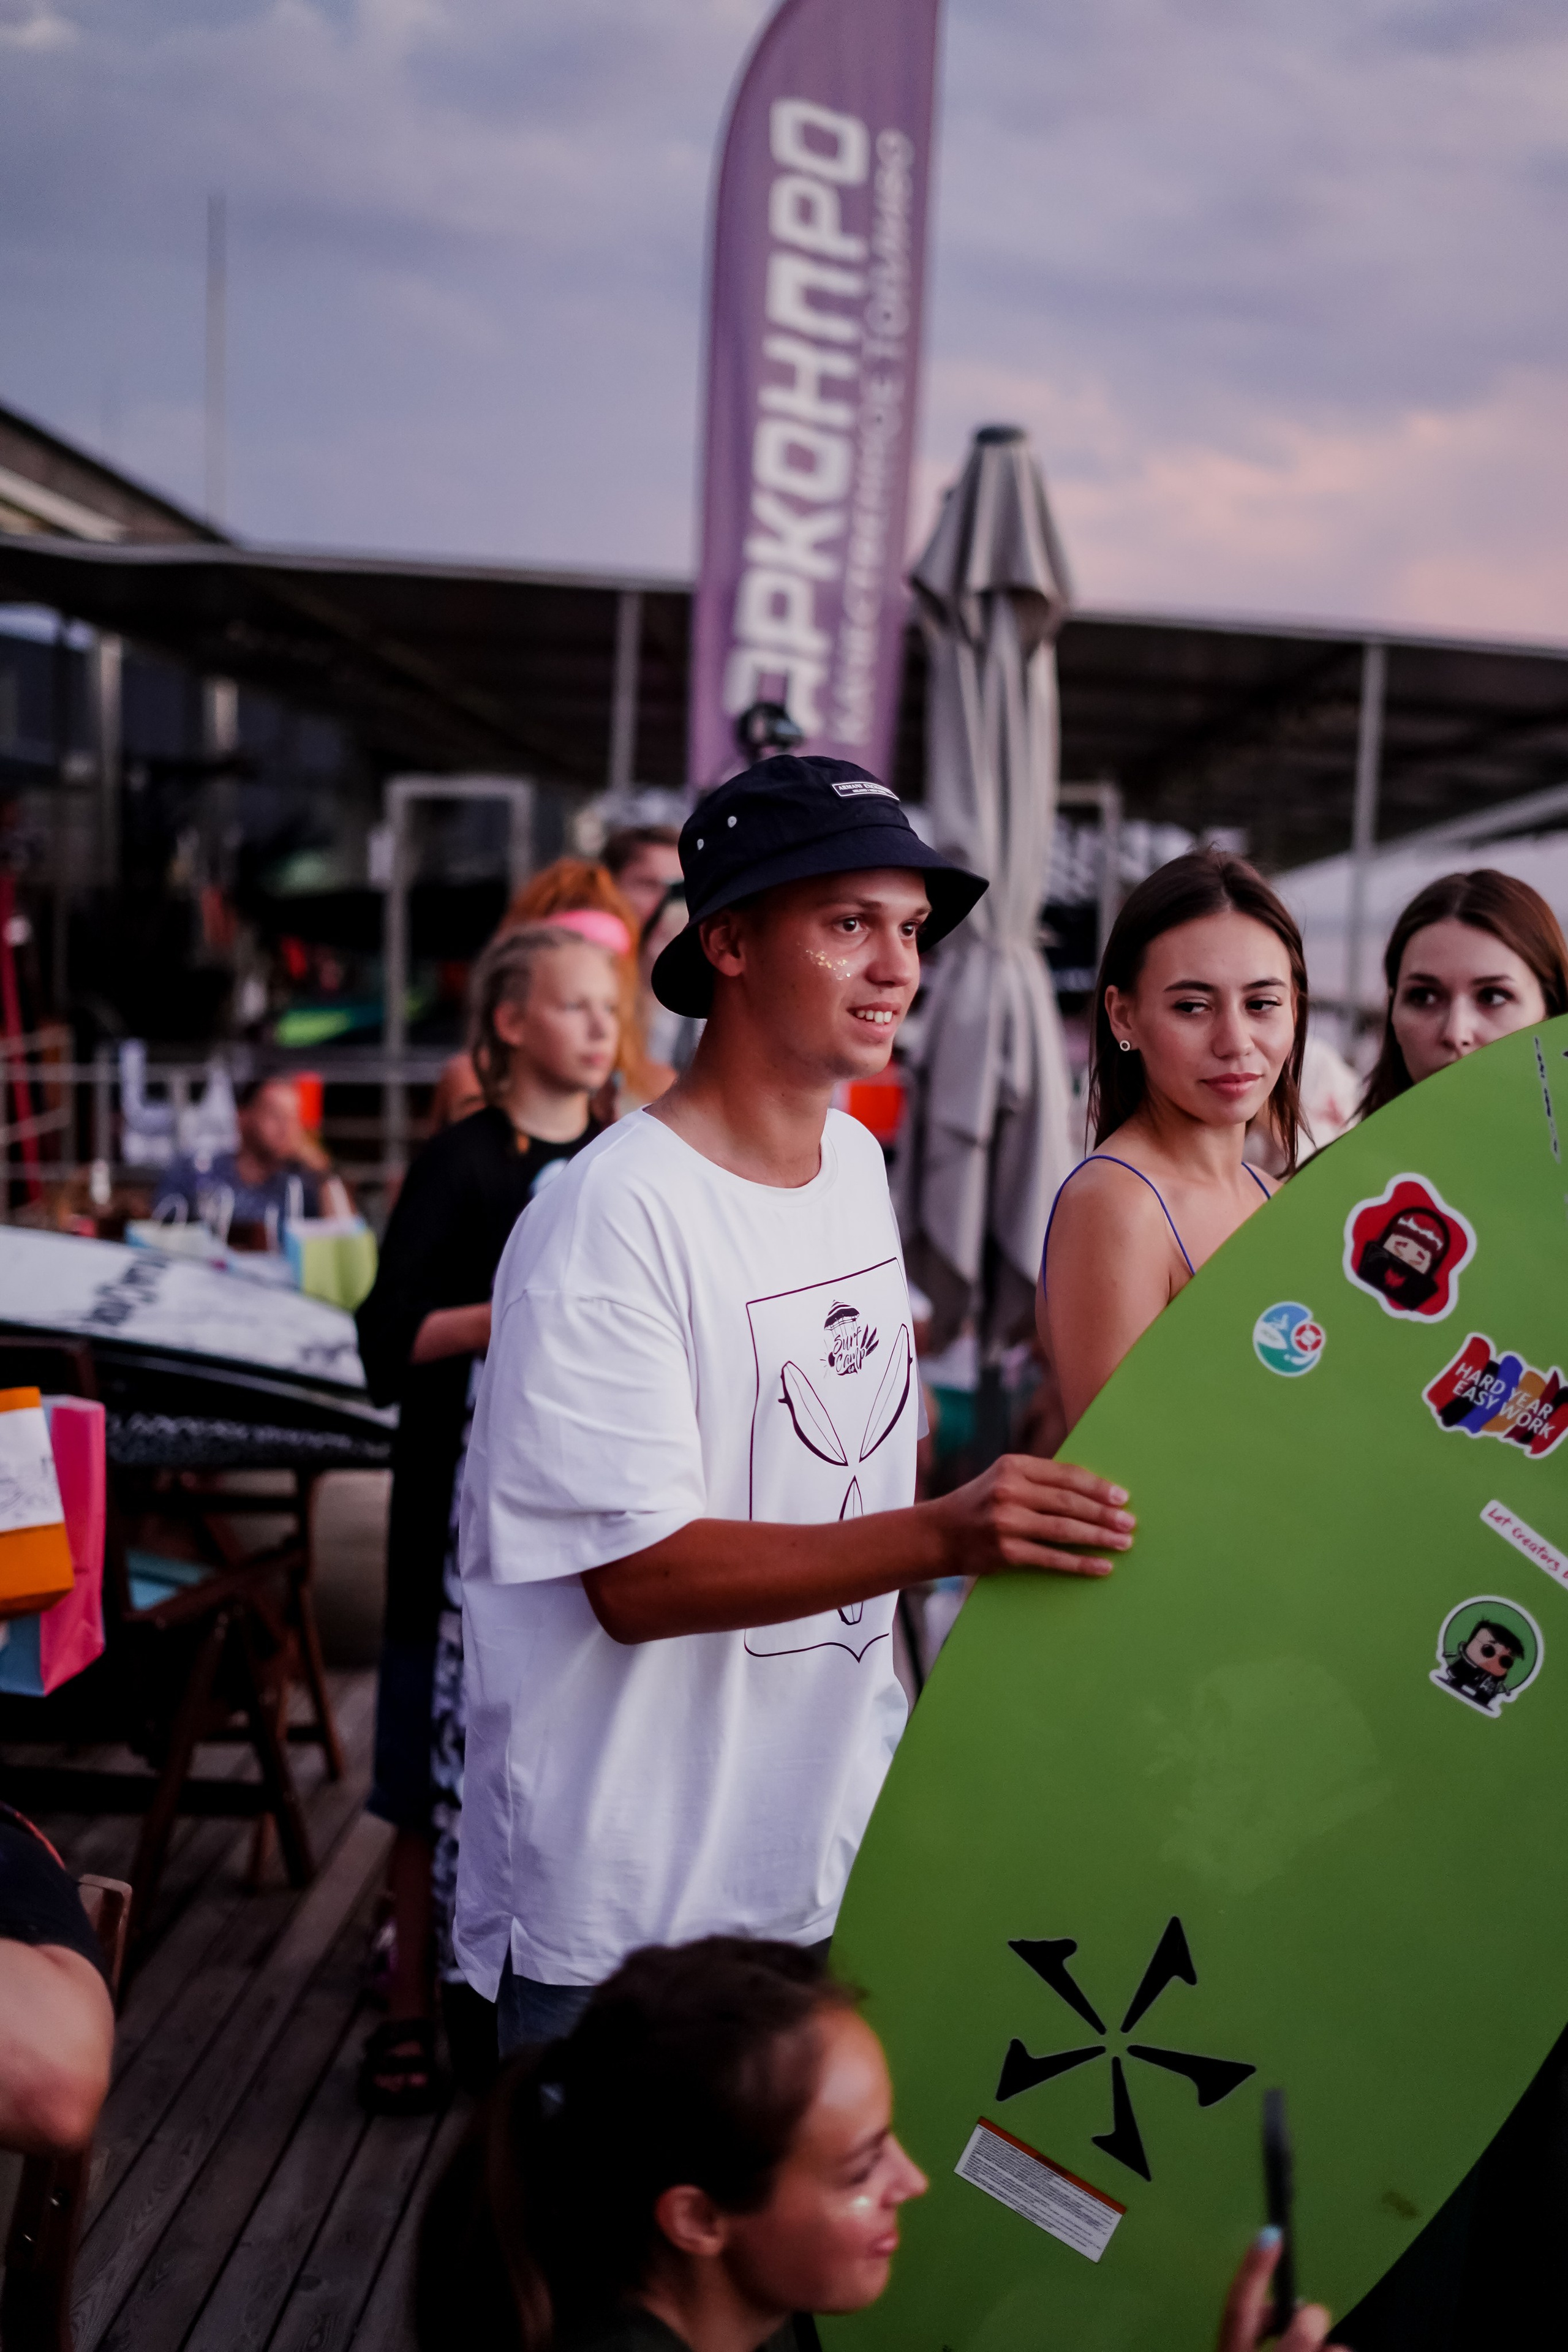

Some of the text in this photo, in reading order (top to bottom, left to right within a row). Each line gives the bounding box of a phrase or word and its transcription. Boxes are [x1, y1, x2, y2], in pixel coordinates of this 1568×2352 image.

[834, 1326, 861, 1355] Surf
[835, 1347, 865, 1373] Camp
[1455, 1362, 1553, 1420] HARD YEAR
[1453, 1380, 1556, 1439] EASY WORK
[1488, 1508, 1512, 1526] Let
